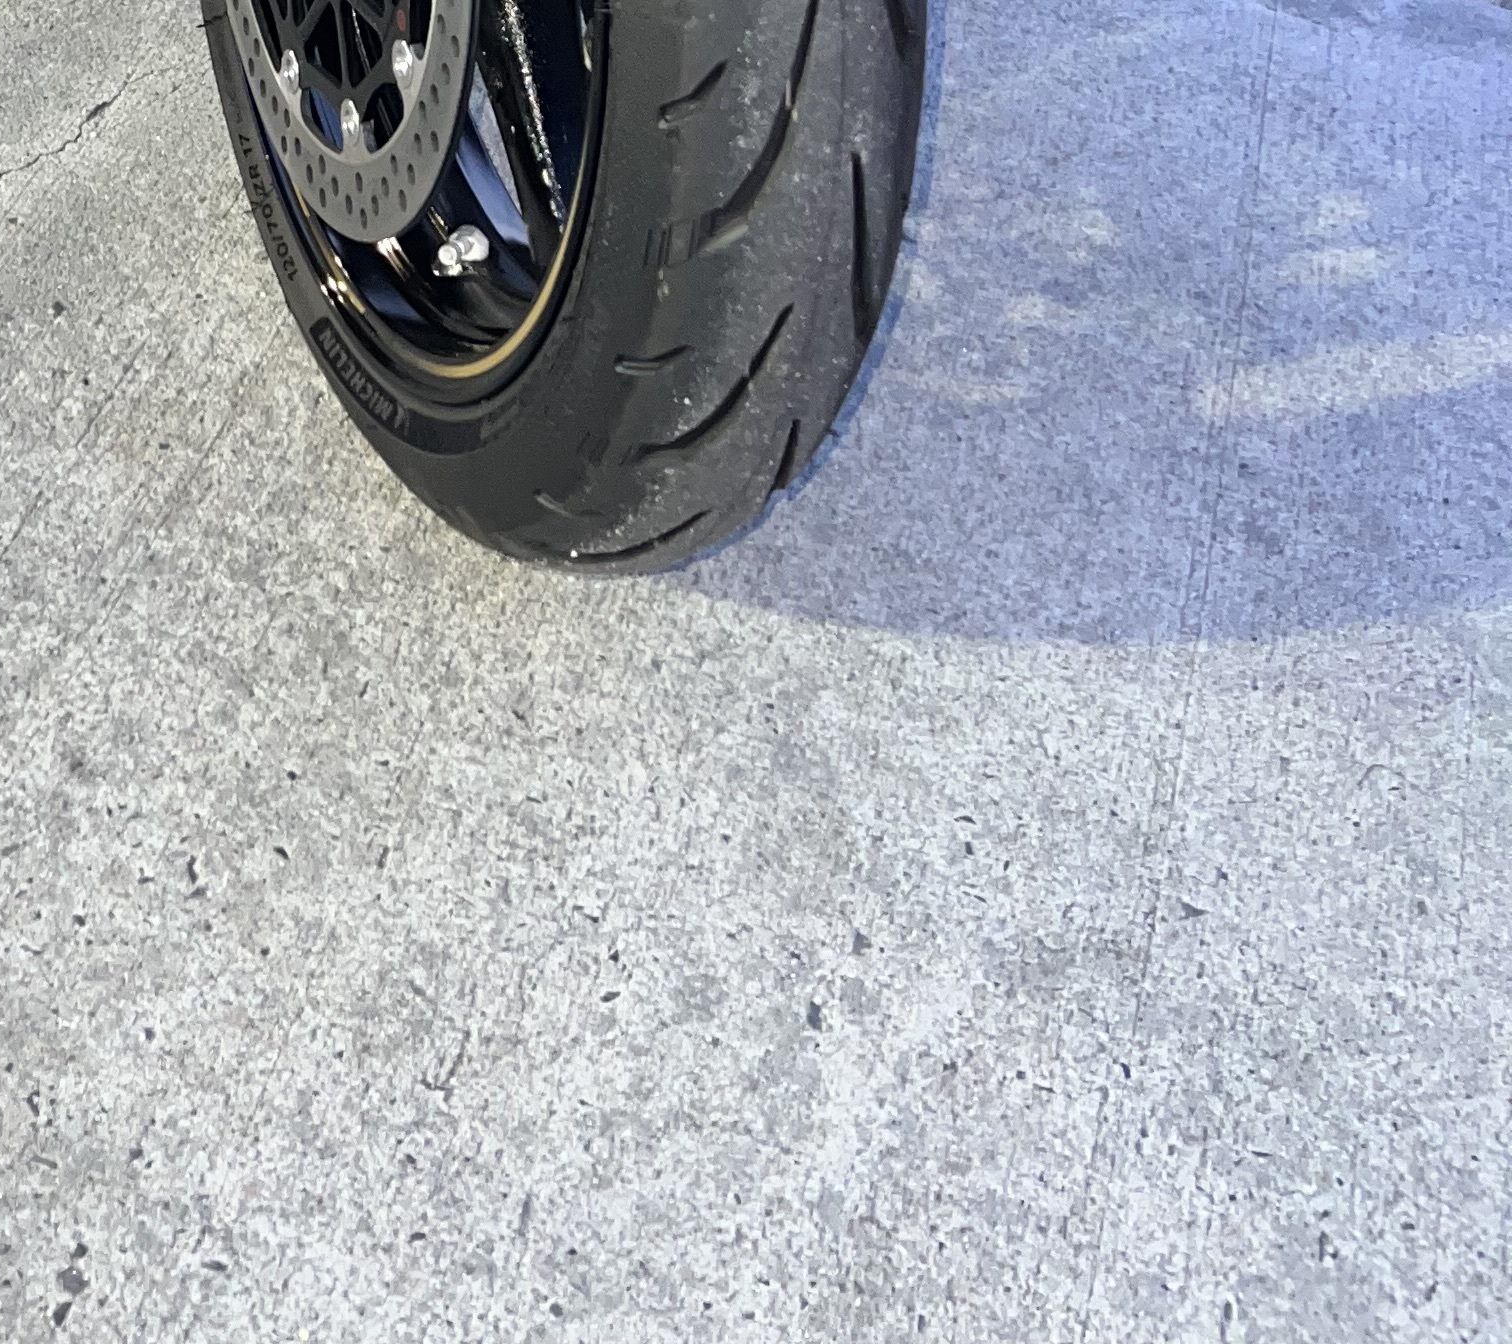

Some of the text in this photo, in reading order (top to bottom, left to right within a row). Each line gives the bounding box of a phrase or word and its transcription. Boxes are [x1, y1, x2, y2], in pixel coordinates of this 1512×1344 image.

[238, 133, 253, 159] 17
[261, 203, 299, 281] 120/70
[319, 326, 393, 422] MICHELIN
